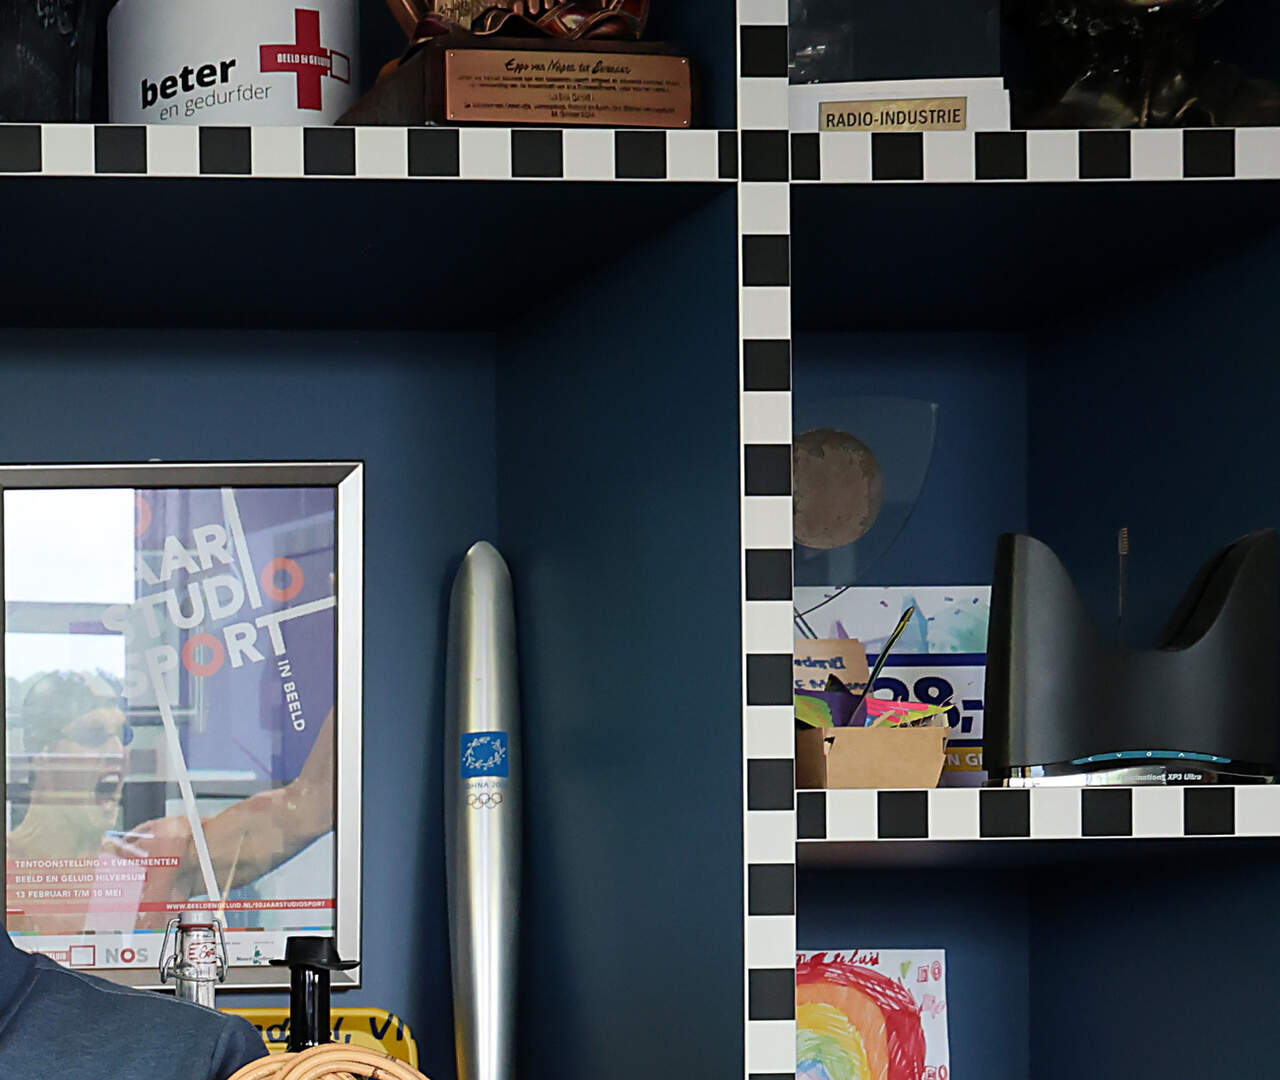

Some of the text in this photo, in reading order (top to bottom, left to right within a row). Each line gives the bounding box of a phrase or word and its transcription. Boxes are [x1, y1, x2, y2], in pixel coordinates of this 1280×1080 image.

[141, 59, 236, 109] beter
[160, 84, 272, 120] en gedurfder
[825, 108, 962, 129] RADIO-INDUSTRIE
[277, 660, 306, 732] IN BEELD
[15, 858, 178, 869] TENTOONSTELLING EVENEMENTEN
[15, 872, 146, 883] BEELD EN GELUID HILVERSUM
[28, 890, 71, 898] FEBRUARI
[105, 889, 122, 897] MEI
[106, 948, 149, 965] NOS
